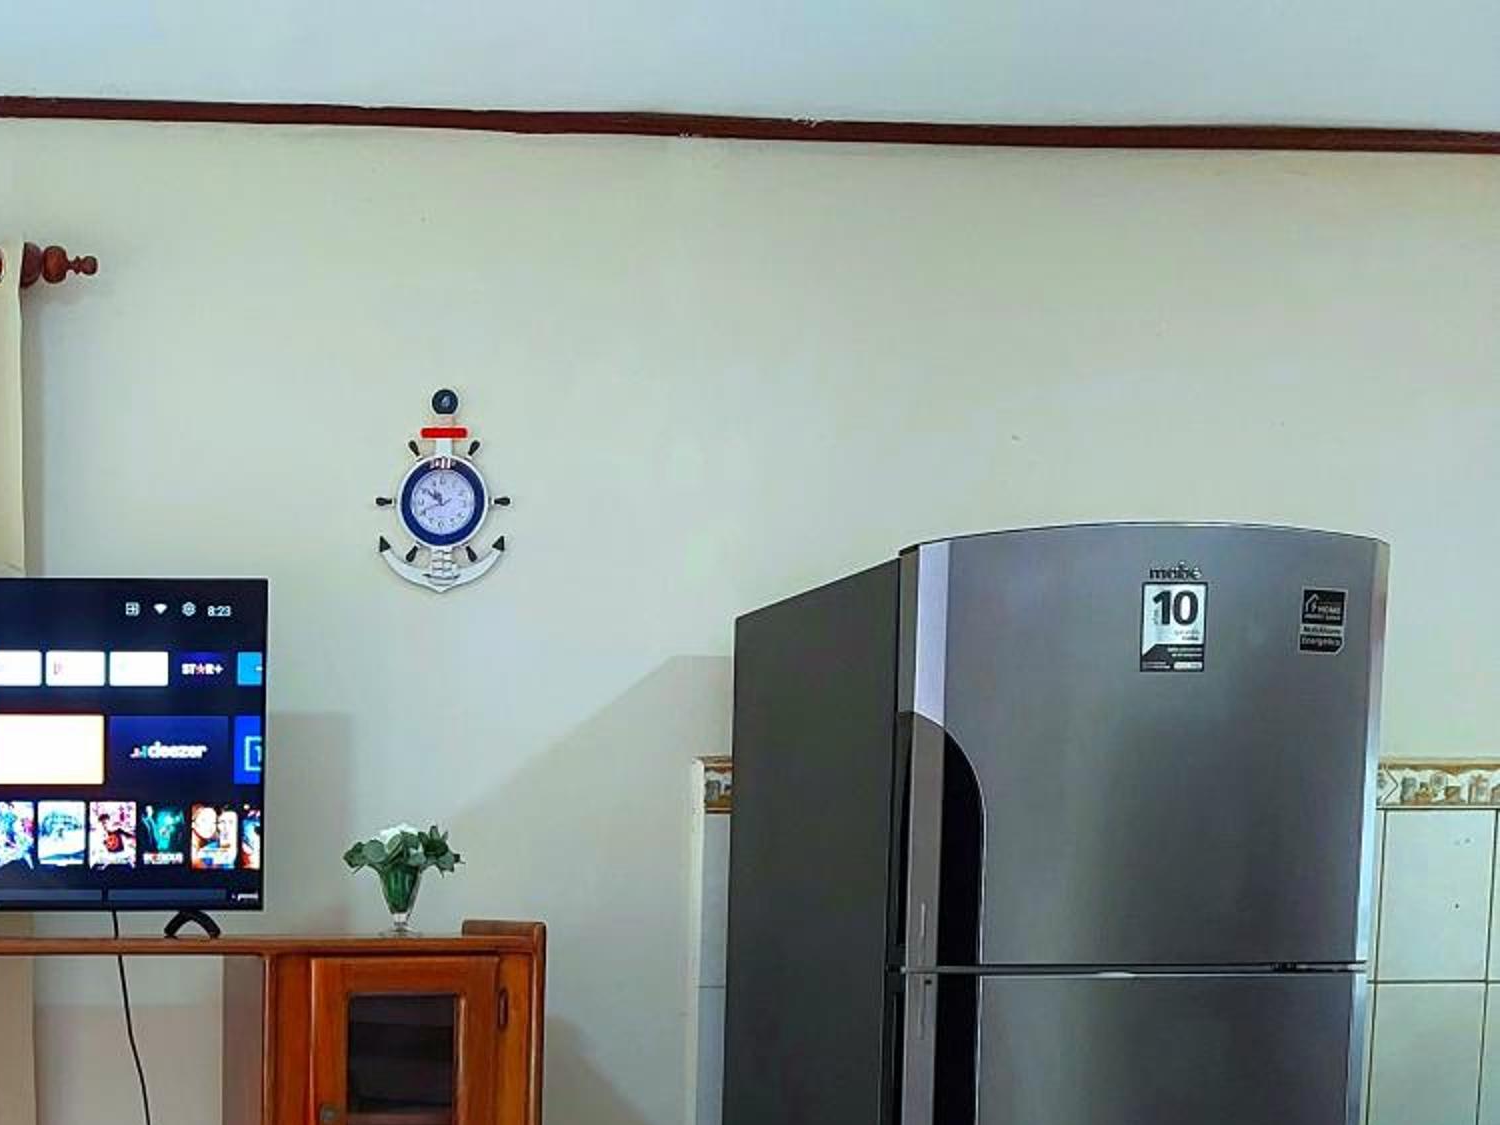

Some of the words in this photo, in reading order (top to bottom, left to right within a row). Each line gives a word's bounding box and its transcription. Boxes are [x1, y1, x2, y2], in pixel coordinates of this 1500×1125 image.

[207, 605, 231, 617] 8:23
[1153, 590, 1199, 626] 10
[147, 740, 208, 758] deezer
